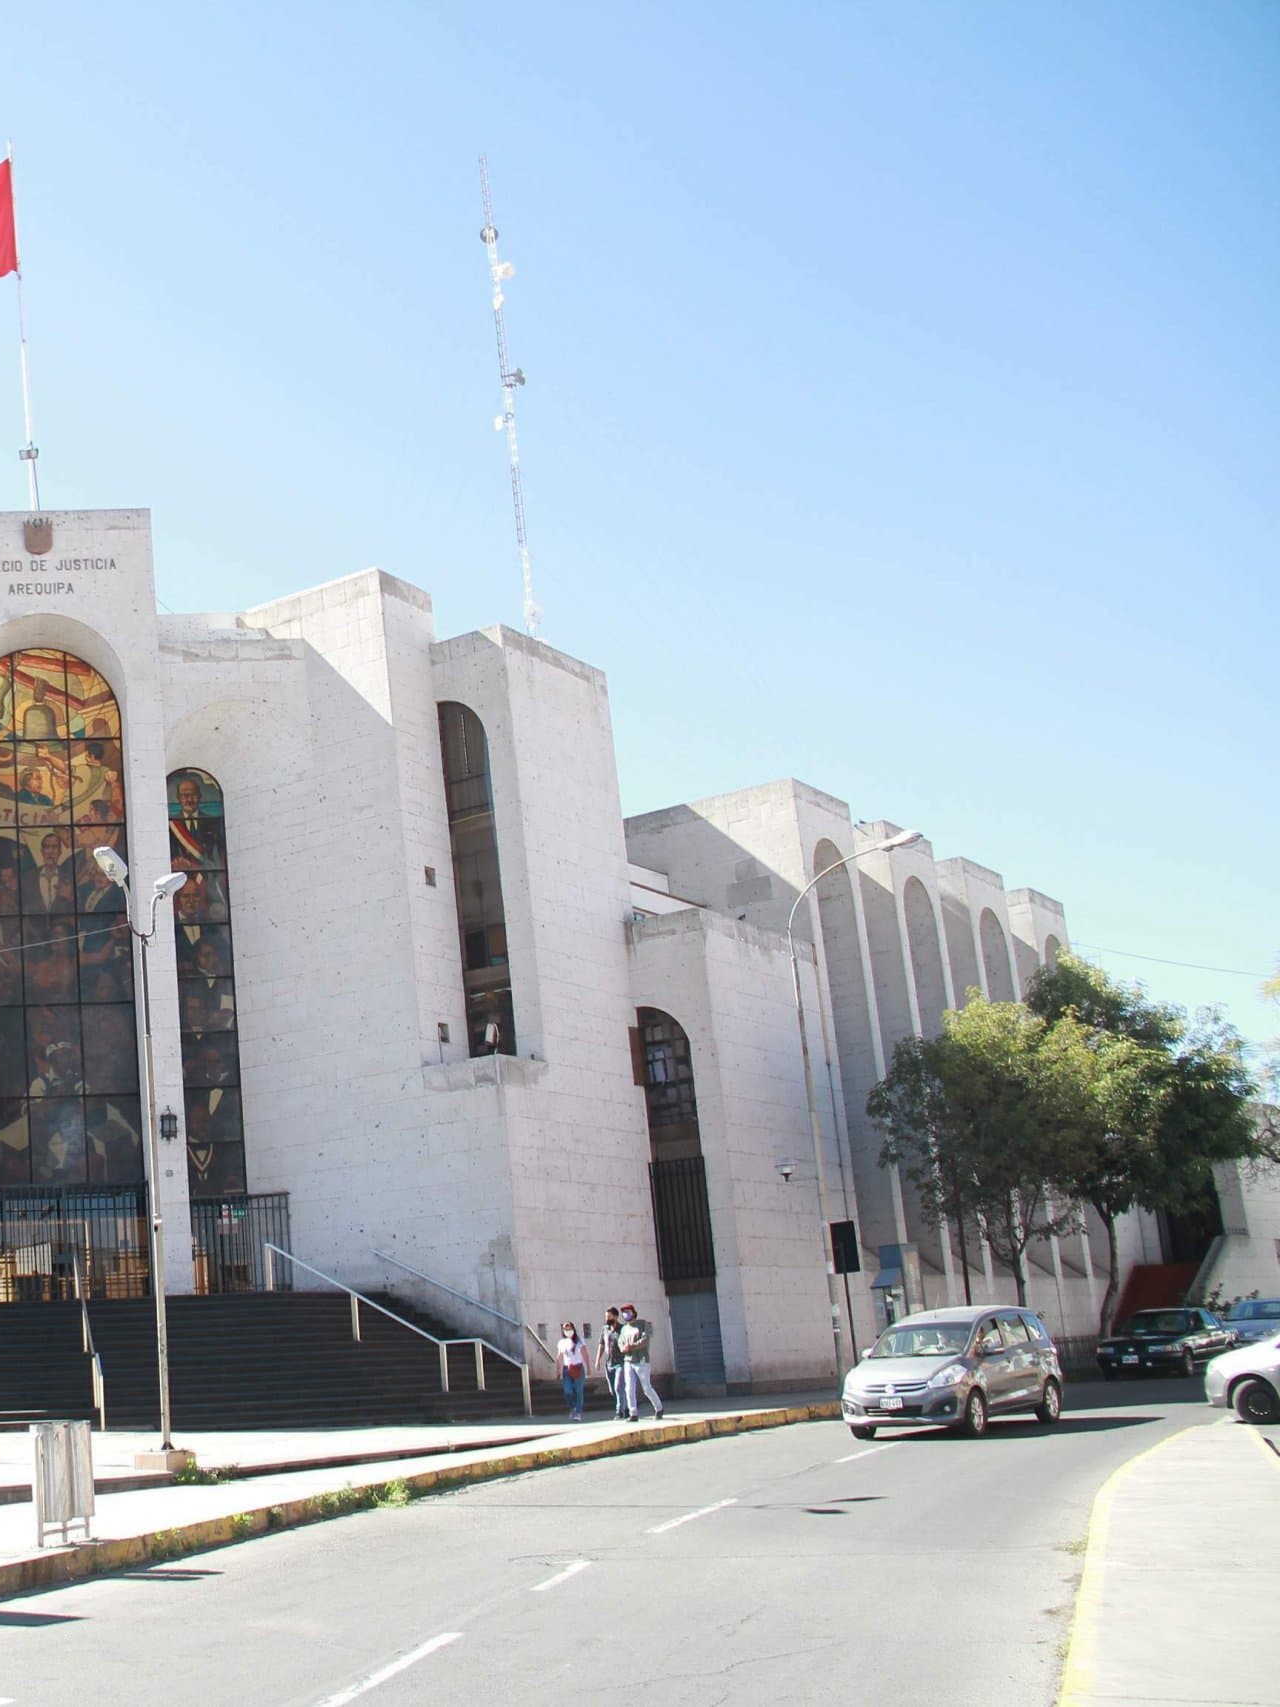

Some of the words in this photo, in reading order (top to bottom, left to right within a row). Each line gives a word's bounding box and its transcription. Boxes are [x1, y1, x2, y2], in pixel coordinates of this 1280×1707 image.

[31, 560, 47, 572] DE
[55, 558, 117, 571] JUSTICIA
[8, 583, 74, 595] AREQUIPA
